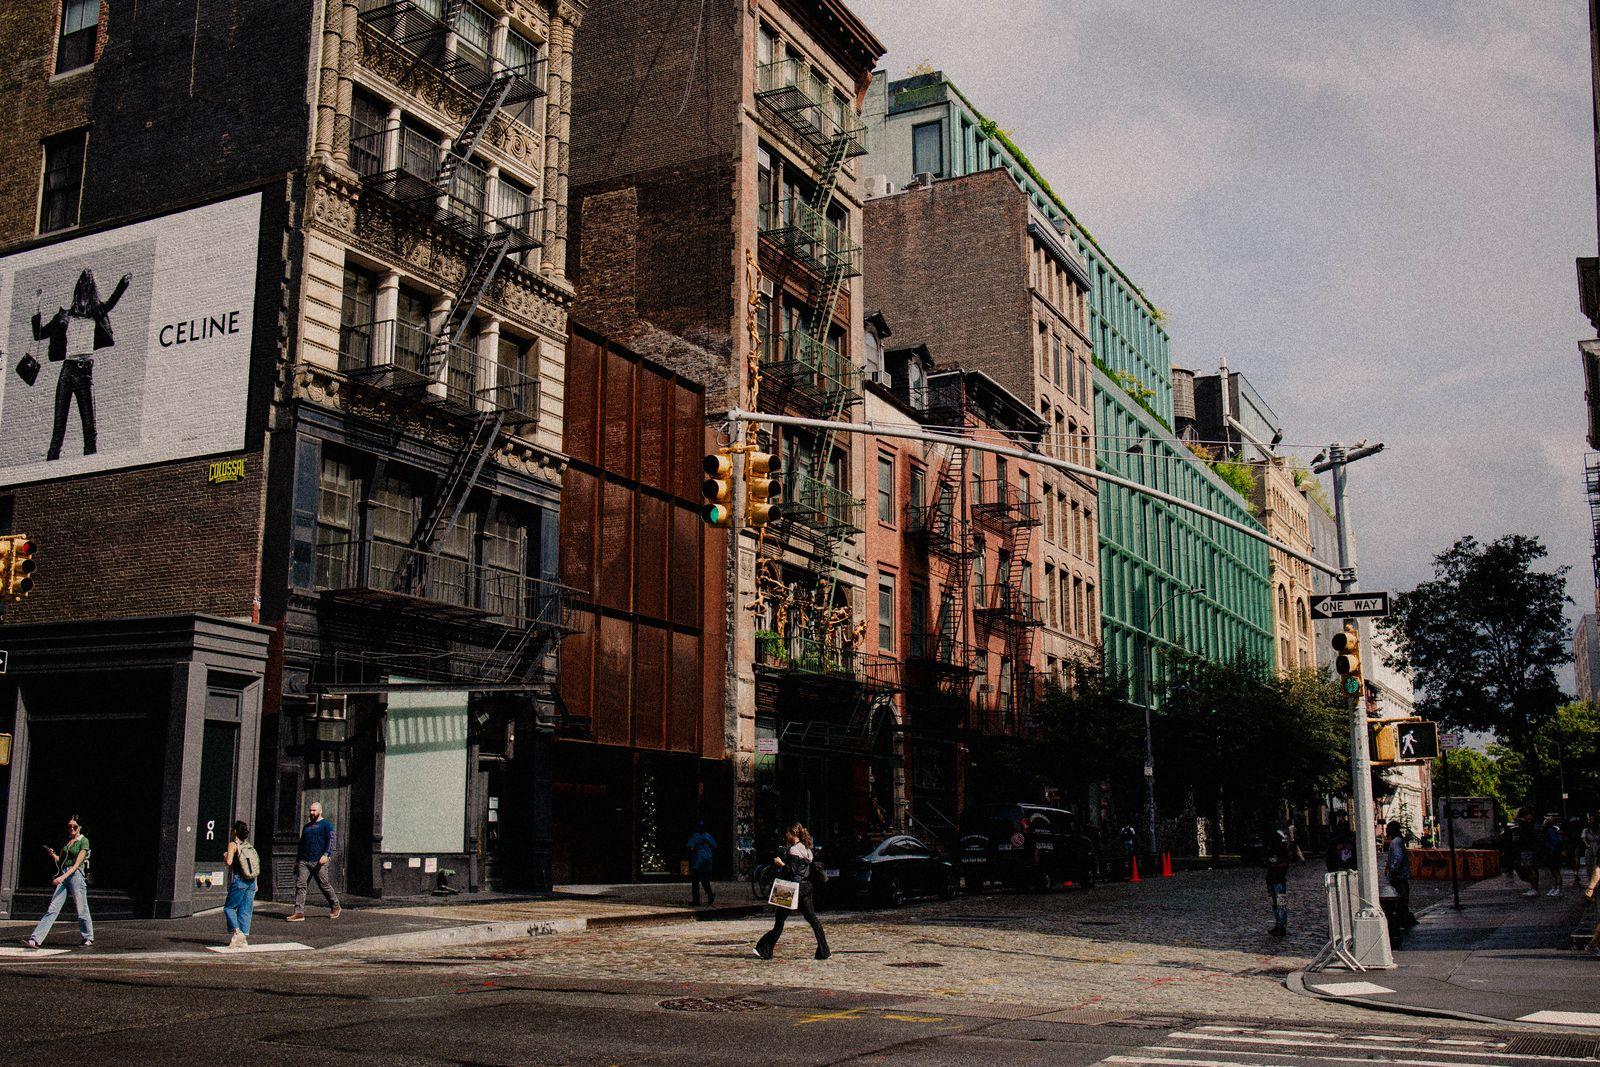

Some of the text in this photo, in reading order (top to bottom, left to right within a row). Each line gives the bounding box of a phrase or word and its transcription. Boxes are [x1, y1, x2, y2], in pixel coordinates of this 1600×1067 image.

[159, 310, 240, 348] CELINE
[208, 459, 246, 482] COLOSSAL
[1321, 599, 1378, 612] ONE WAY
